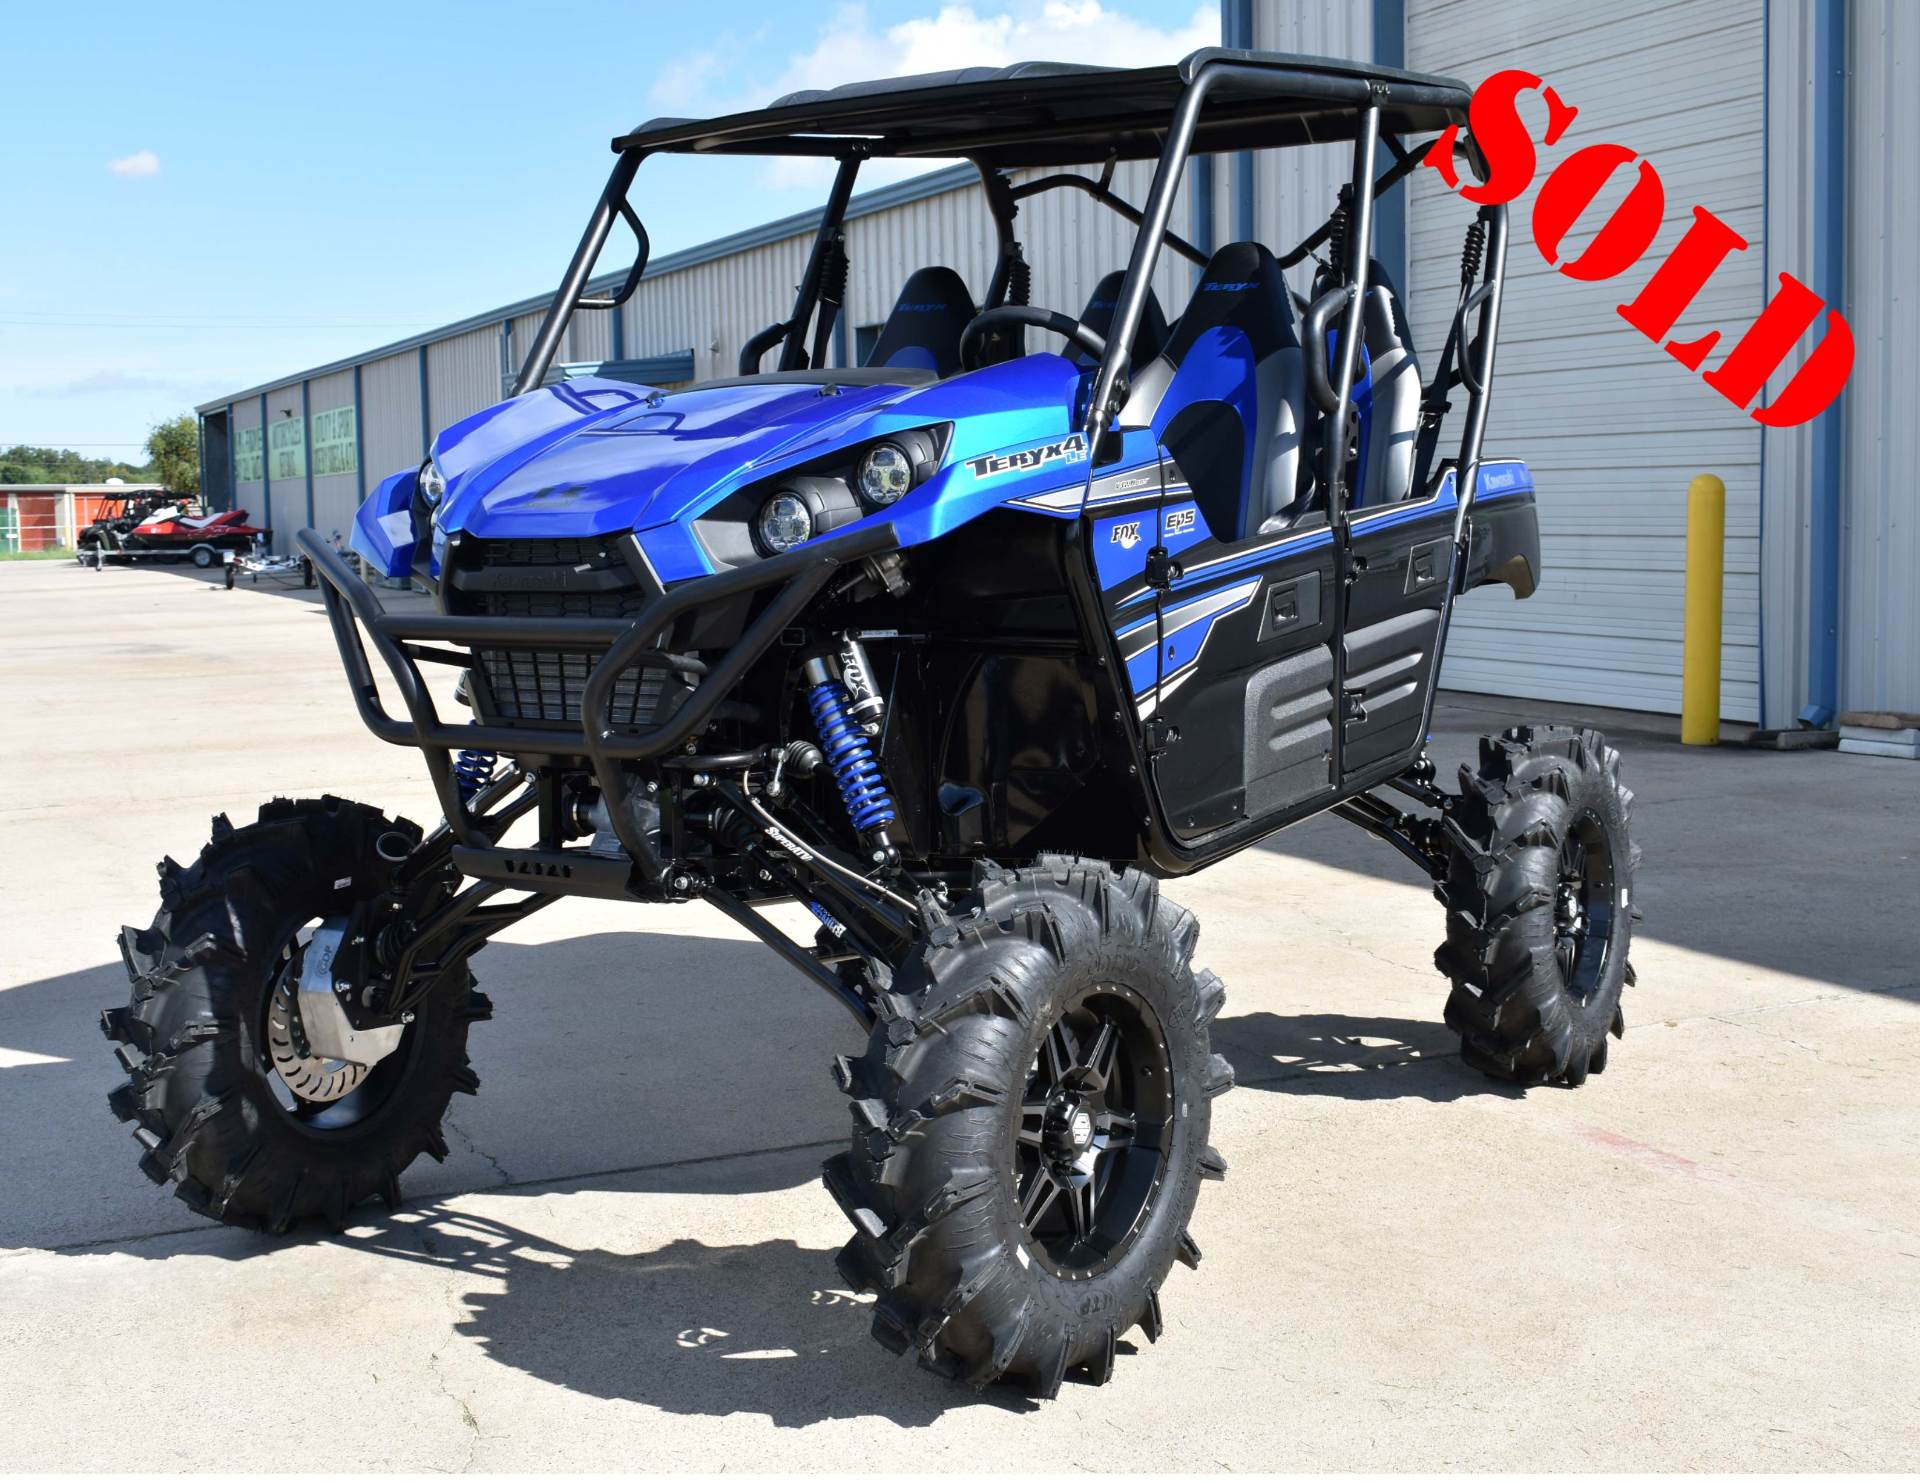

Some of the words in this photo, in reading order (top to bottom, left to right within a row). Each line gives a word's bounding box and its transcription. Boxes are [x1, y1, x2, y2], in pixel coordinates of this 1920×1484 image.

[1066, 450, 1087, 465] LE
[1165, 508, 1196, 530] EPS
[1110, 521, 1141, 545] FOX
[840, 651, 871, 697] FOX
